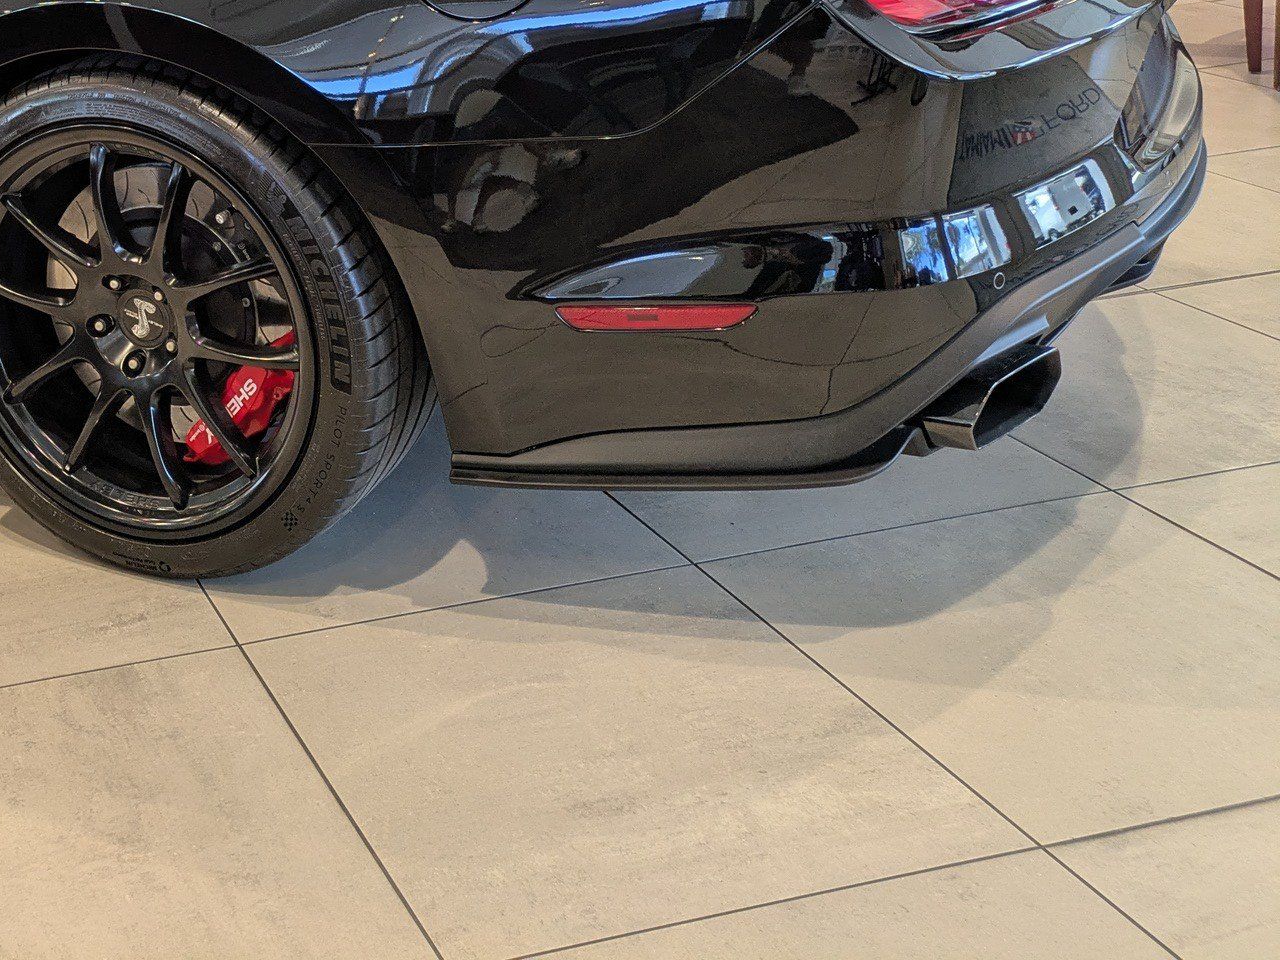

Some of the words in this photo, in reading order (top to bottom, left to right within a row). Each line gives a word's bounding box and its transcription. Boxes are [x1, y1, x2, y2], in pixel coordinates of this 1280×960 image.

[283, 214, 352, 385] MICHELIN
[331, 405, 348, 448] PILOT
[309, 453, 335, 499] SPORT
